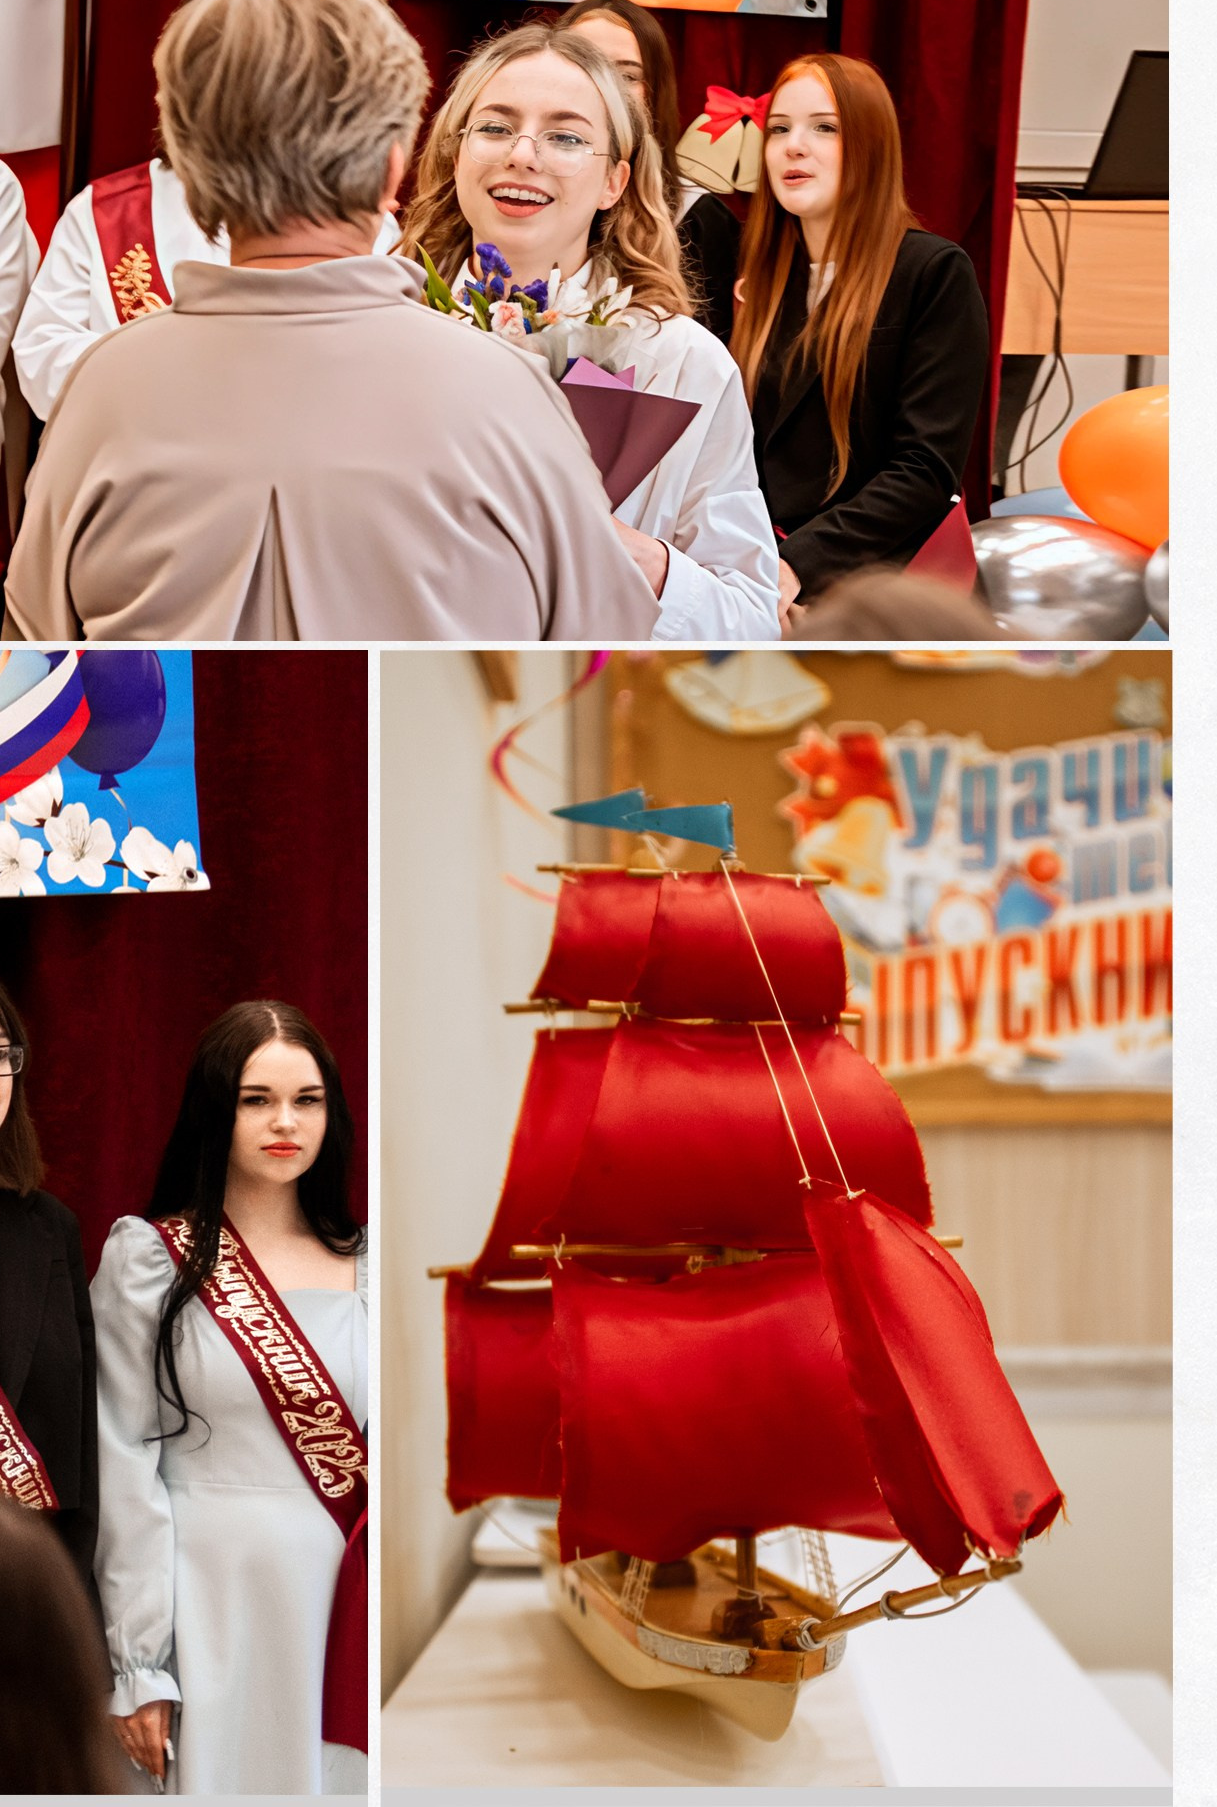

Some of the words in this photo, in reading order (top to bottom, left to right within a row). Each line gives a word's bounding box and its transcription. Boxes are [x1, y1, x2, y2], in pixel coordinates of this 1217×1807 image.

[899, 742, 1151, 871] Удачи
[1071, 833, 1172, 905] те
[839, 910, 1172, 1066] ЫПУСКНИ
[282, 1397, 368, 1499] 2025
